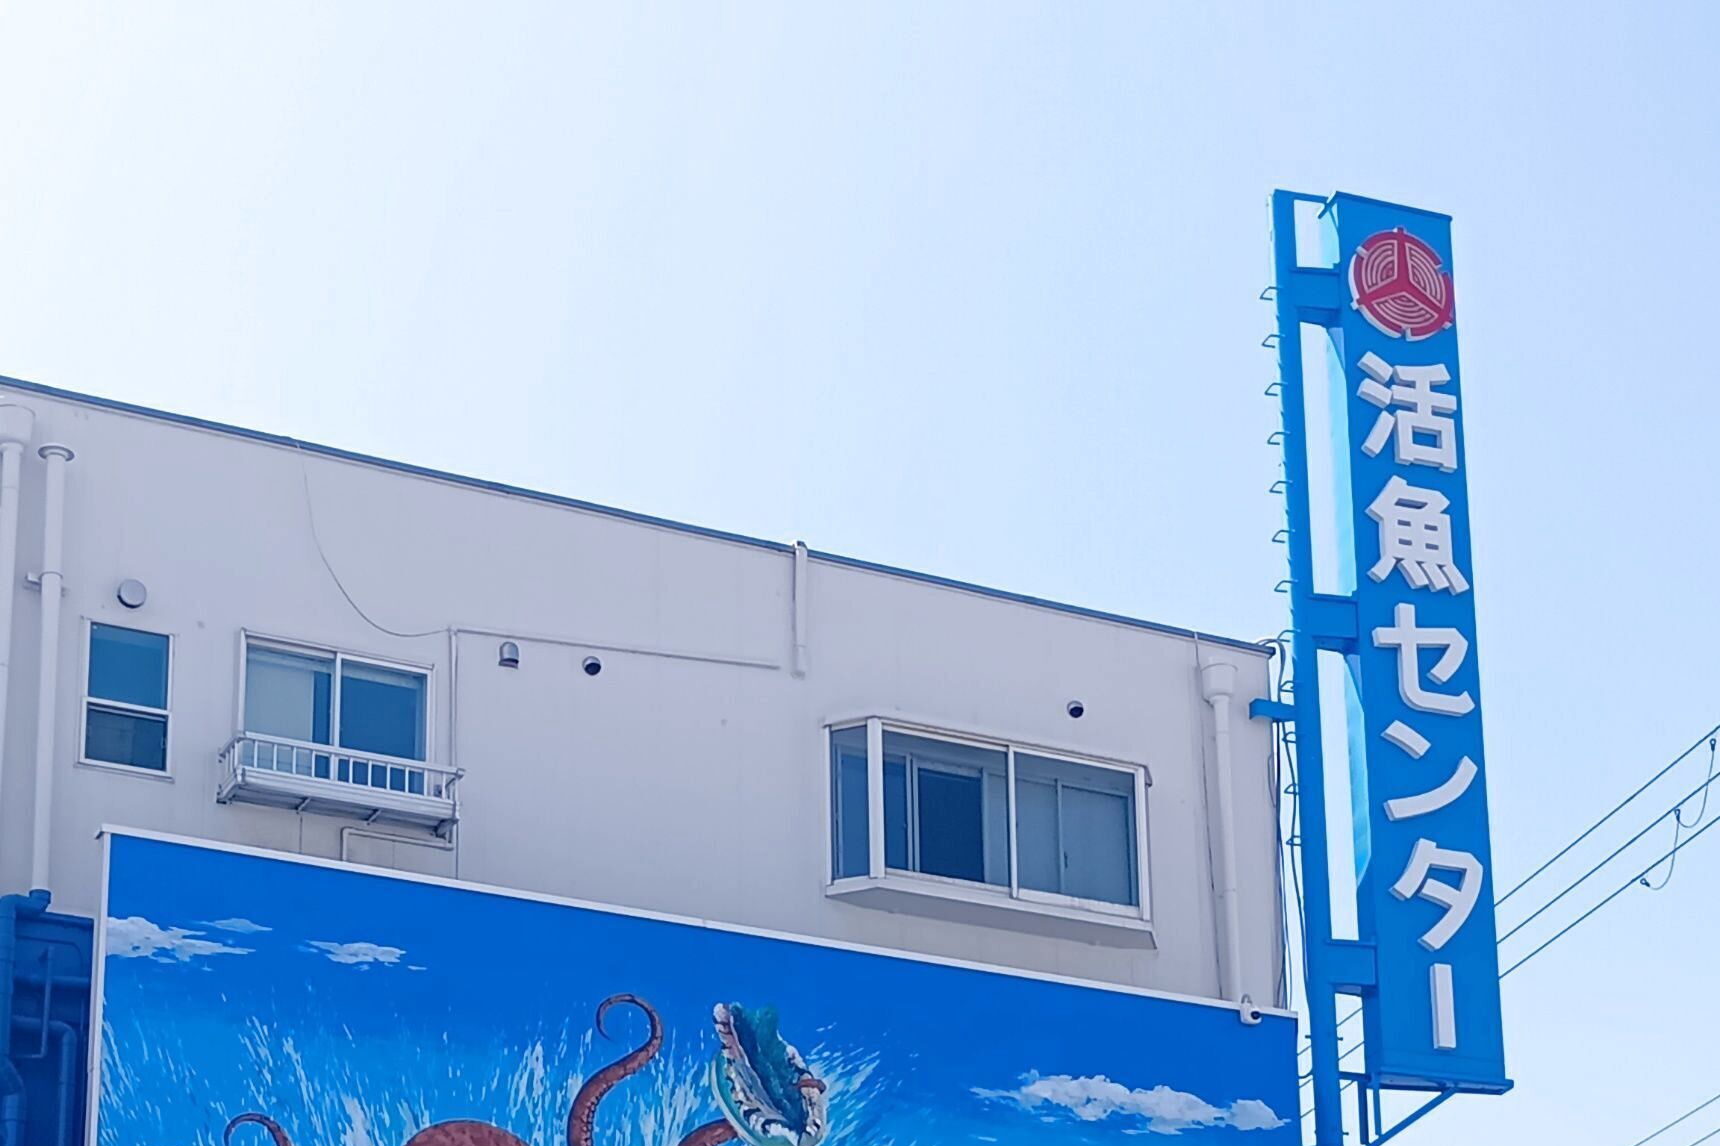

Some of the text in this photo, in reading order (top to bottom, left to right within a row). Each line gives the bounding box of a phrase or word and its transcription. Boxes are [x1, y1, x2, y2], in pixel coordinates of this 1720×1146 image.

[1357, 351, 1484, 1051] 活魚センター
